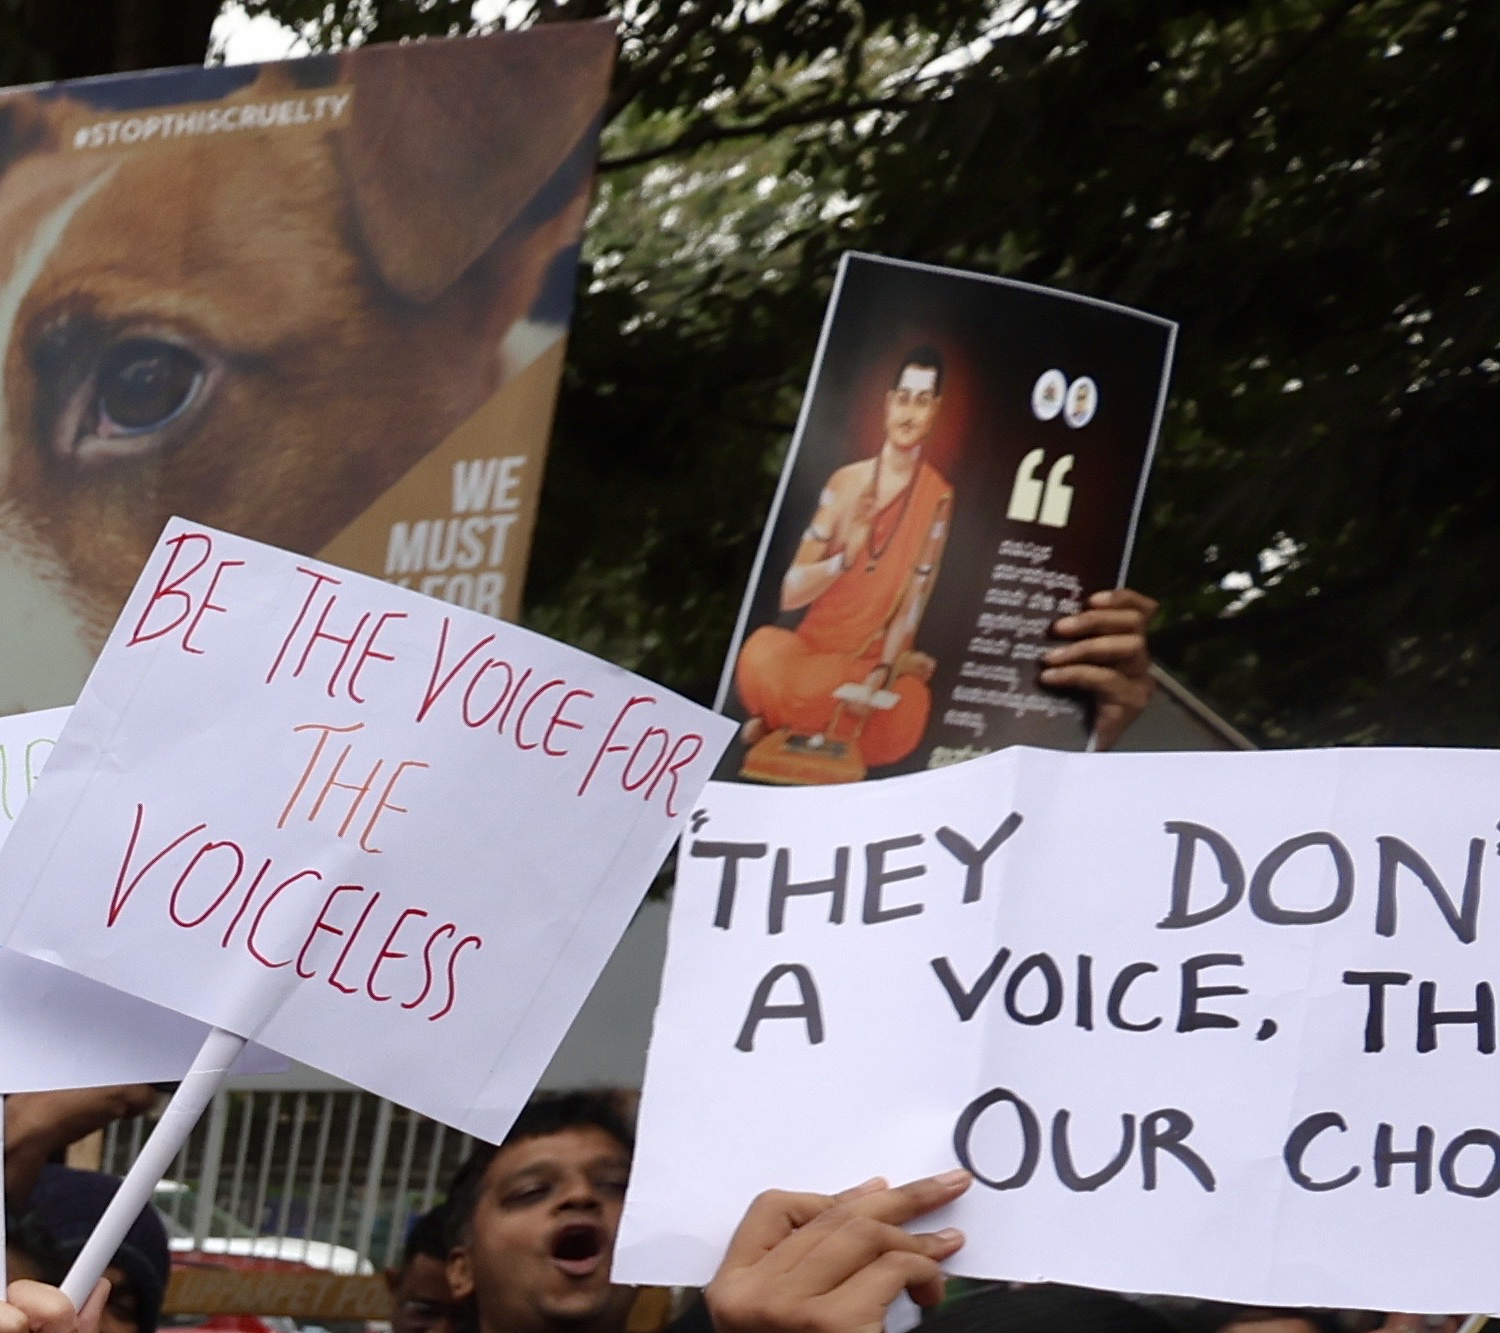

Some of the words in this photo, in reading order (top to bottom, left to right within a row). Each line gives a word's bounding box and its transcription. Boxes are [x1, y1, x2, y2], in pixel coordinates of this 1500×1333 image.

[71, 92, 351, 151] #STOPTHISCRUELTY
[452, 455, 527, 513] WE
[383, 513, 520, 575] MUST
[126, 532, 246, 655] BE
[265, 564, 408, 704] THE
[415, 615, 594, 759] VOICE
[579, 695, 703, 818] FOR
[277, 722, 430, 855] THE
[106, 804, 483, 1022] VOICELESS
[734, 962, 826, 1053] A
[930, 947, 1281, 1043] VOICE,
[952, 1087, 1217, 1194] OUR
